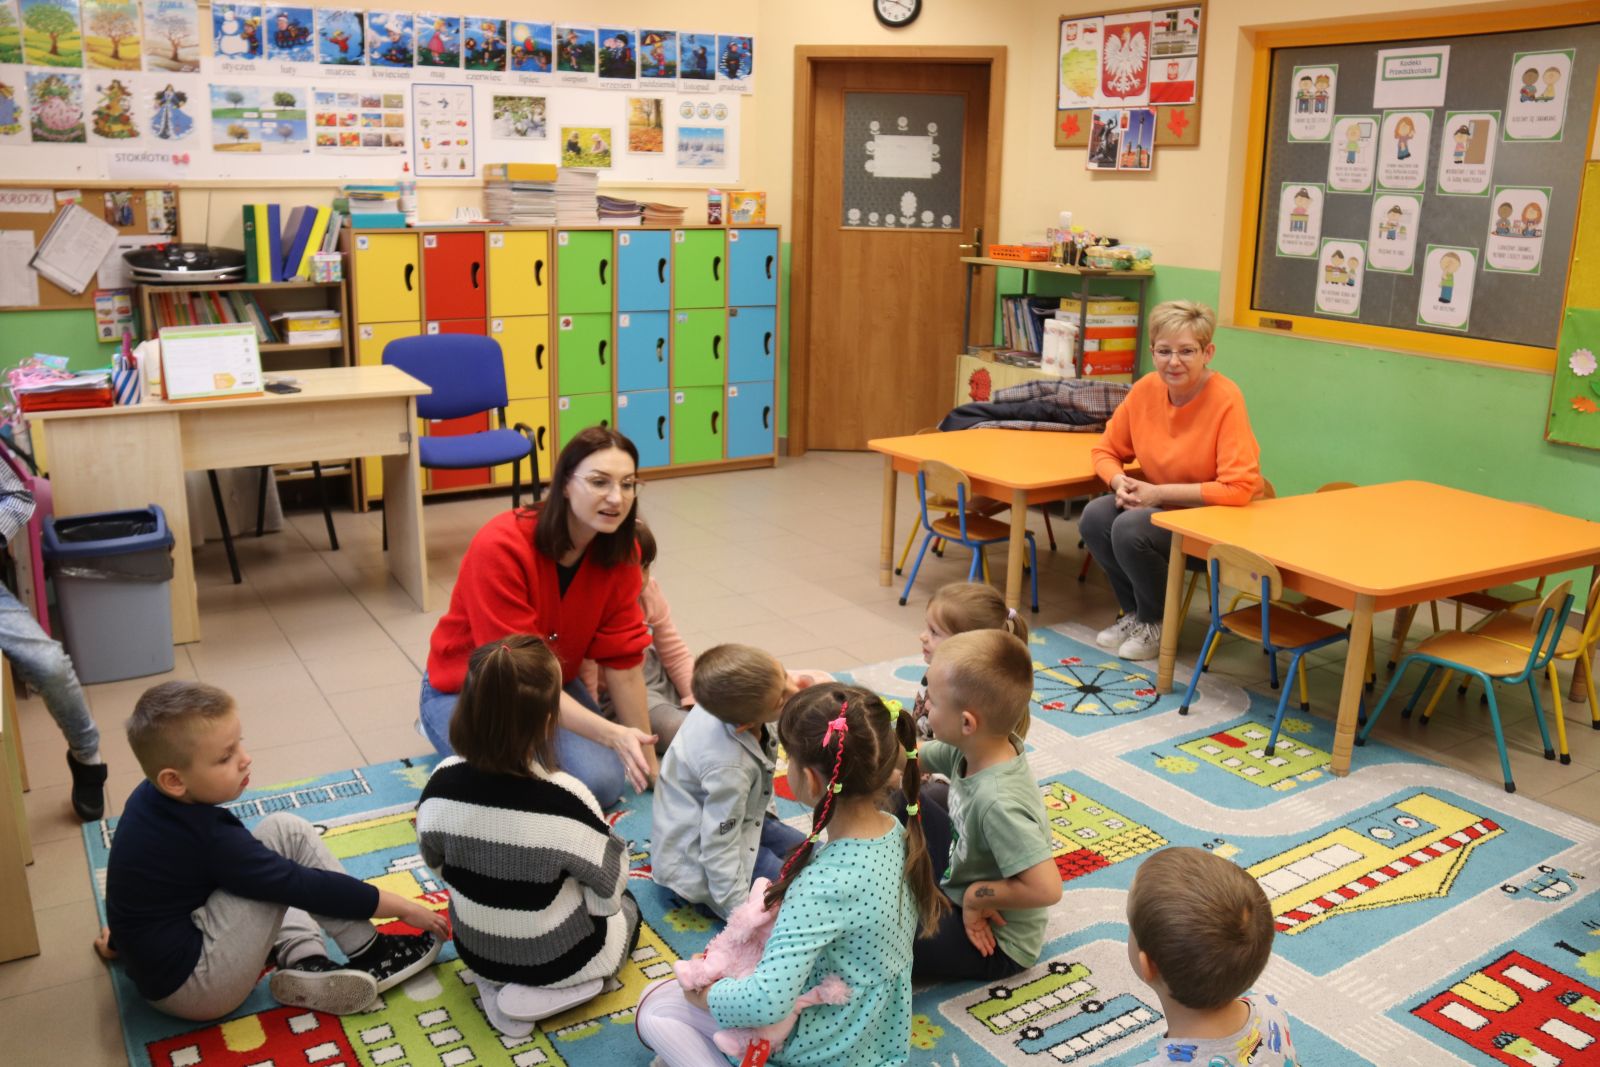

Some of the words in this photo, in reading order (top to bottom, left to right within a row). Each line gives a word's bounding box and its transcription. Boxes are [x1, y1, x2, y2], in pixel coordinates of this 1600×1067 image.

[280, 64, 297, 76] luty
[430, 71, 446, 79] maj
[466, 72, 503, 81] czerwiec
